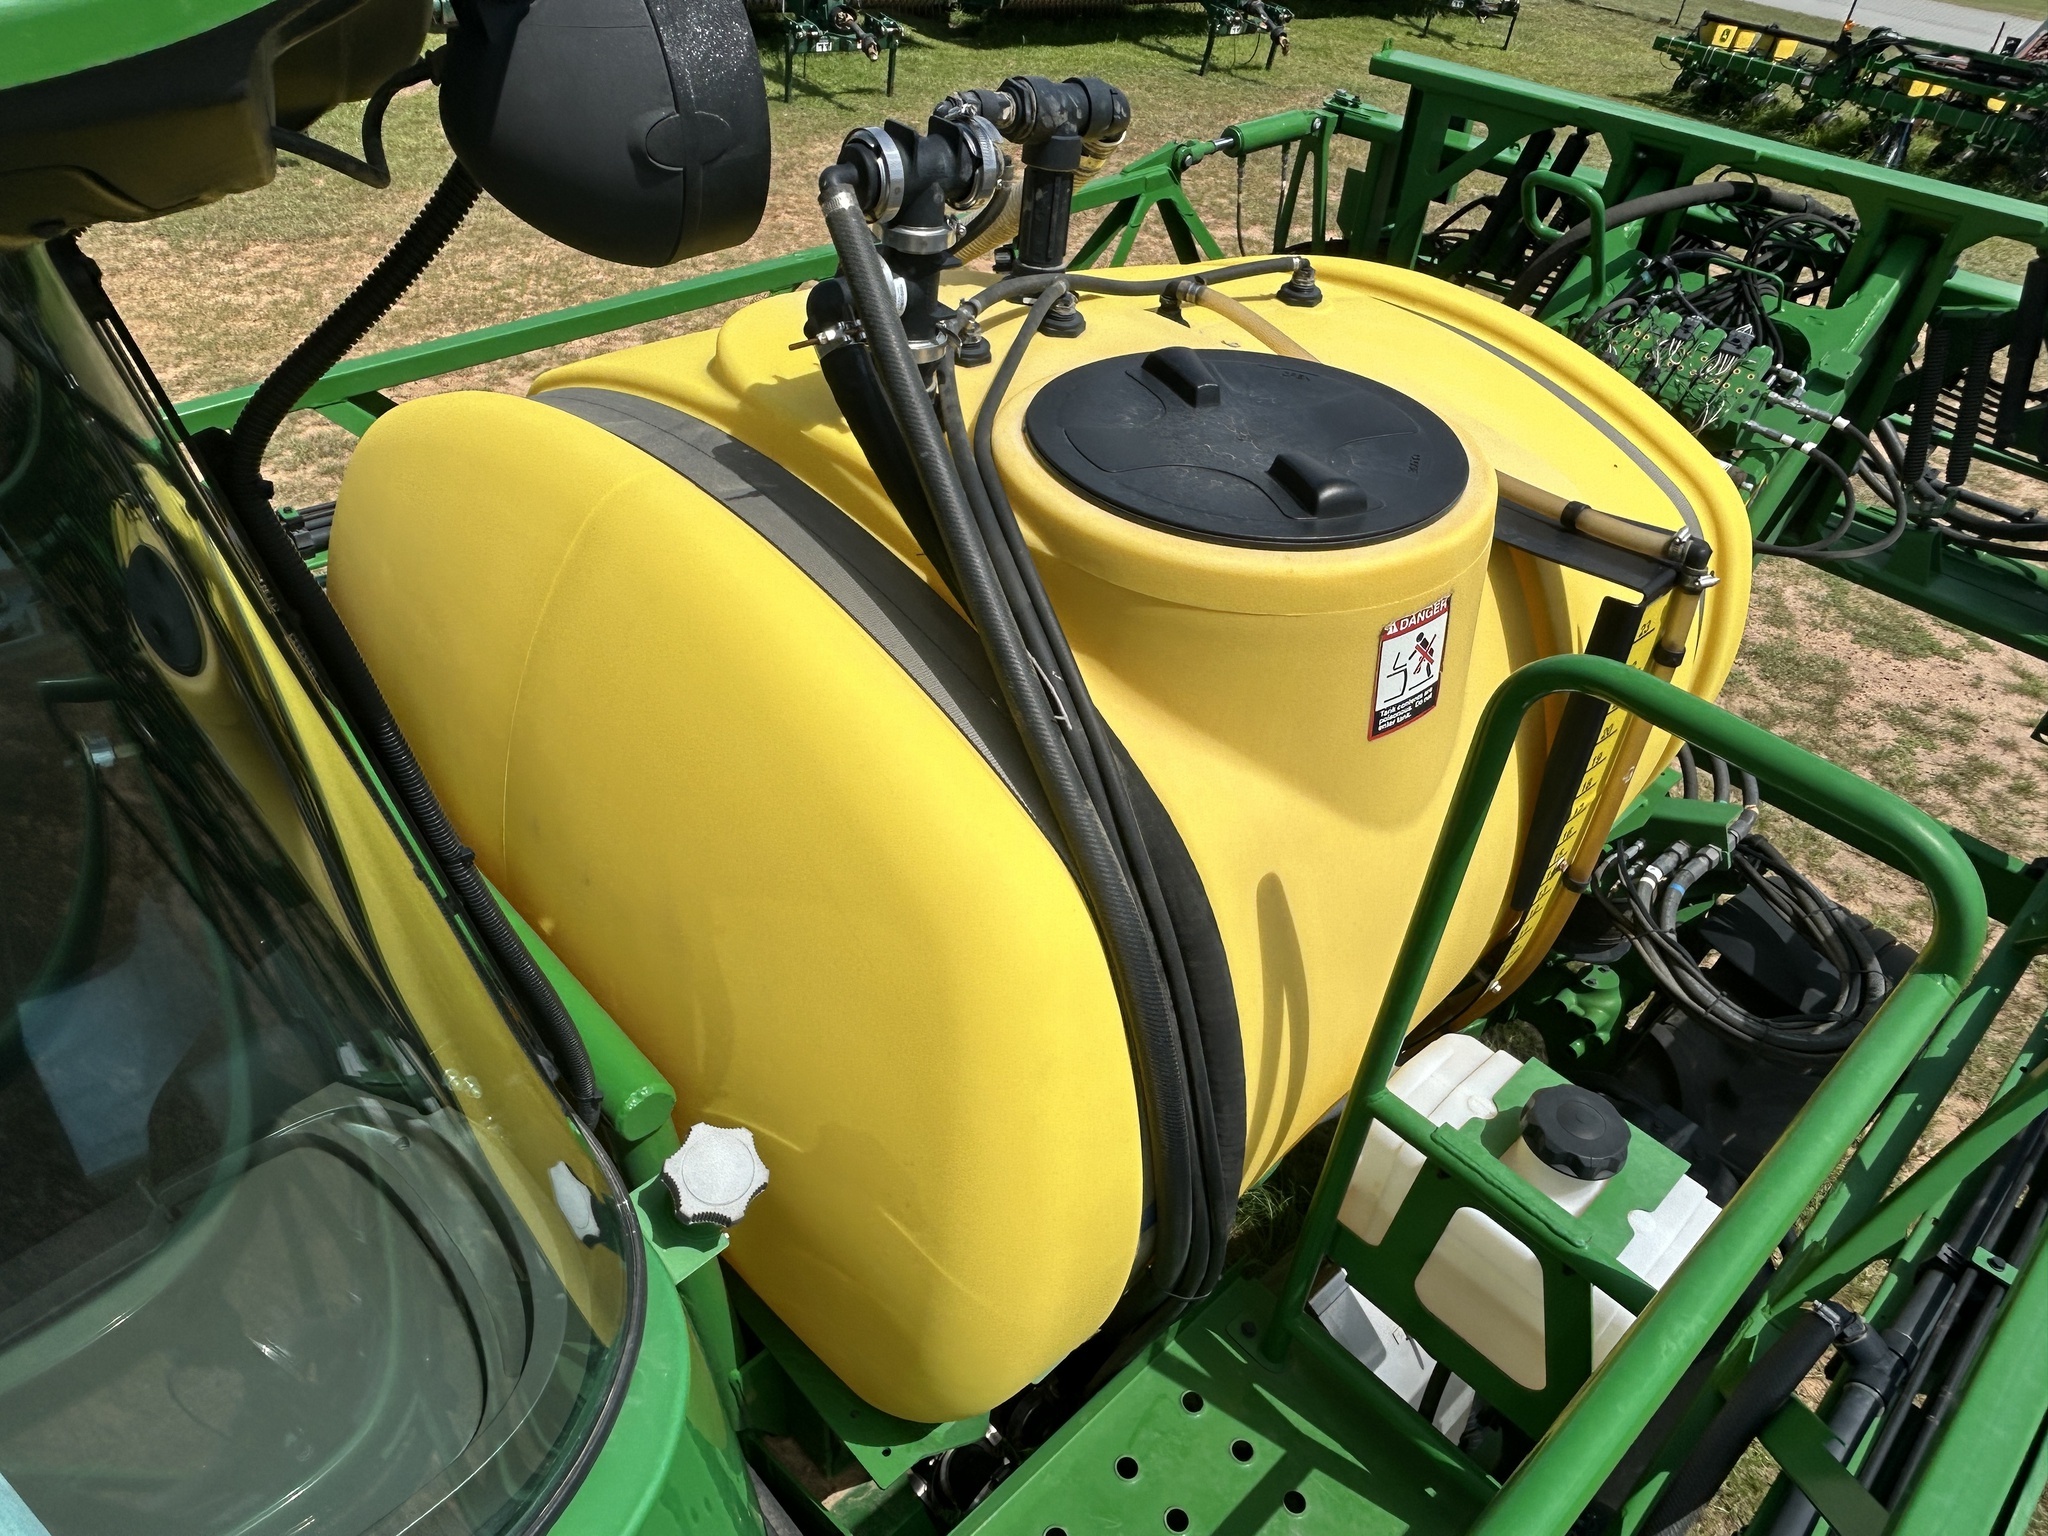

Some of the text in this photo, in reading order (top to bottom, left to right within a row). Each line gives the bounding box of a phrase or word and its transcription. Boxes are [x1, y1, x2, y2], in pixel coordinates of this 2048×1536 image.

[1399, 597, 1448, 631] DANGER
[1639, 619, 1652, 638] 23
[1380, 704, 1396, 717] Tank
[1378, 718, 1396, 732] enter
[1600, 723, 1614, 740] 20
[1591, 751, 1603, 767] 19
